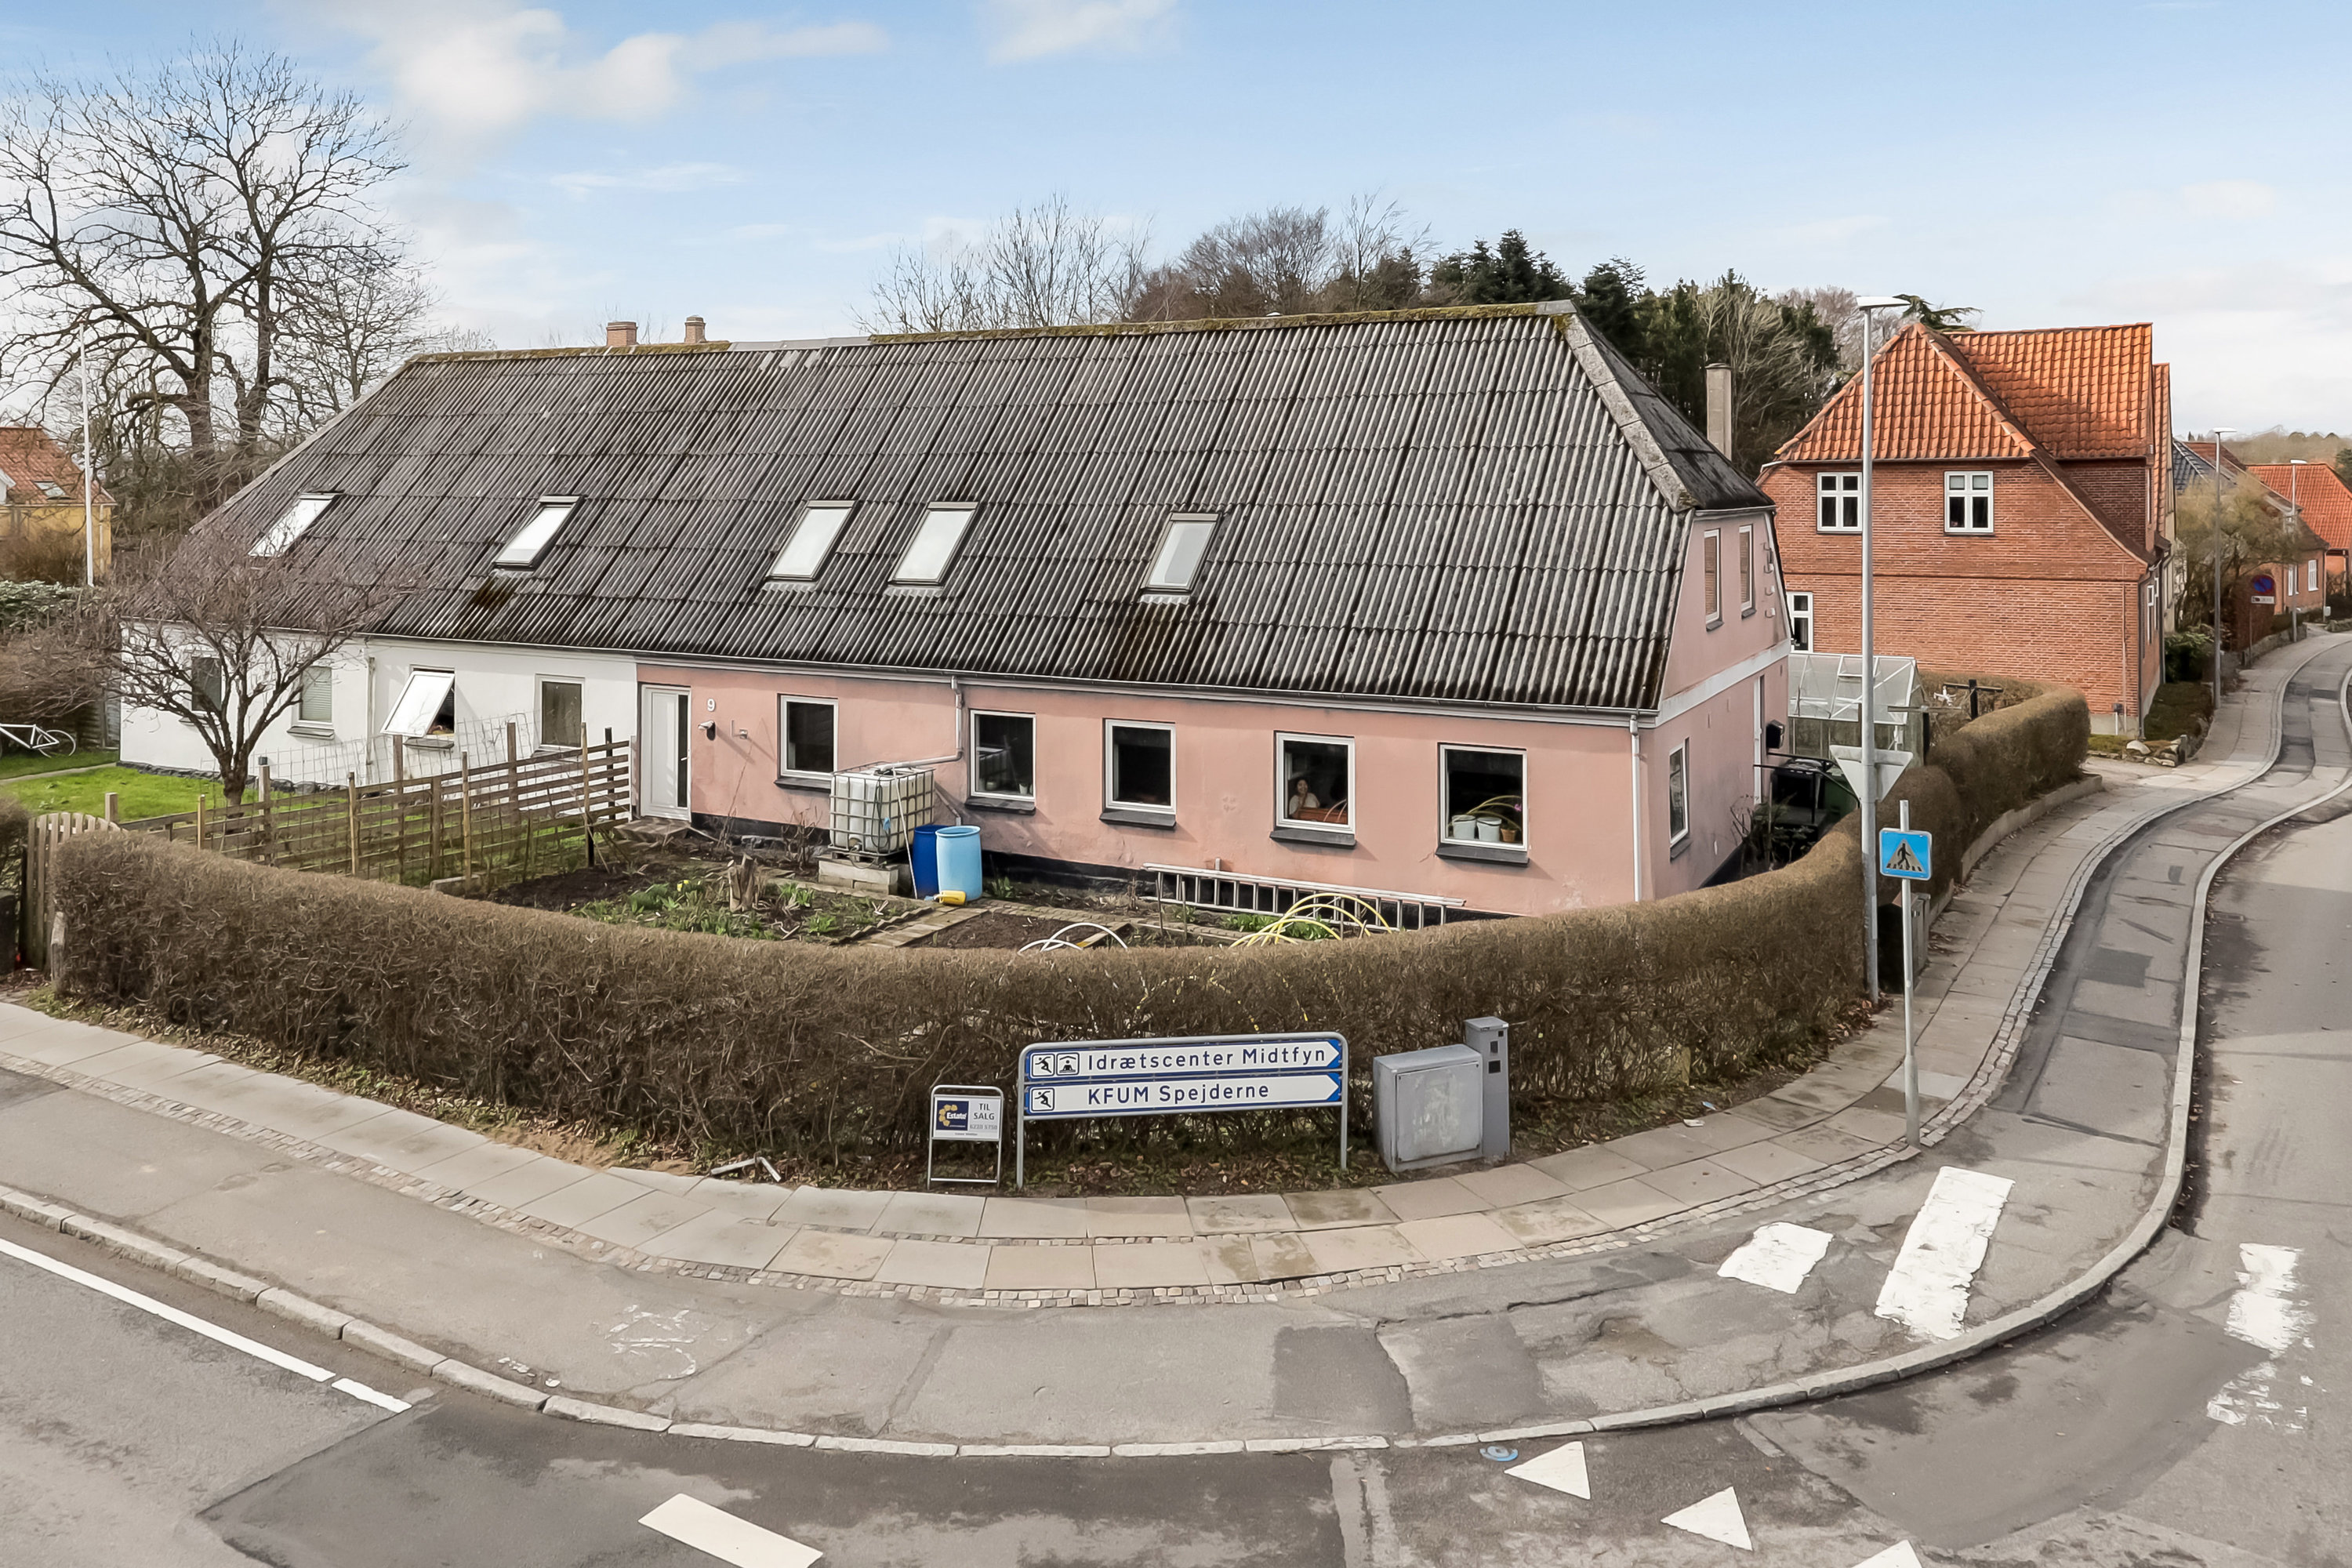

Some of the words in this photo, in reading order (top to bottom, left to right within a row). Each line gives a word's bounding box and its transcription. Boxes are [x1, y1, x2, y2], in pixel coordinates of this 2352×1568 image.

[707, 698, 715, 712] 9
[1087, 1053, 1233, 1070] Idrætscenter
[1243, 1047, 1325, 1065] Midtfyn
[1087, 1087, 1149, 1105] KFUM
[1159, 1084, 1269, 1104] Spejderne
[973, 1112, 995, 1120] SALG
